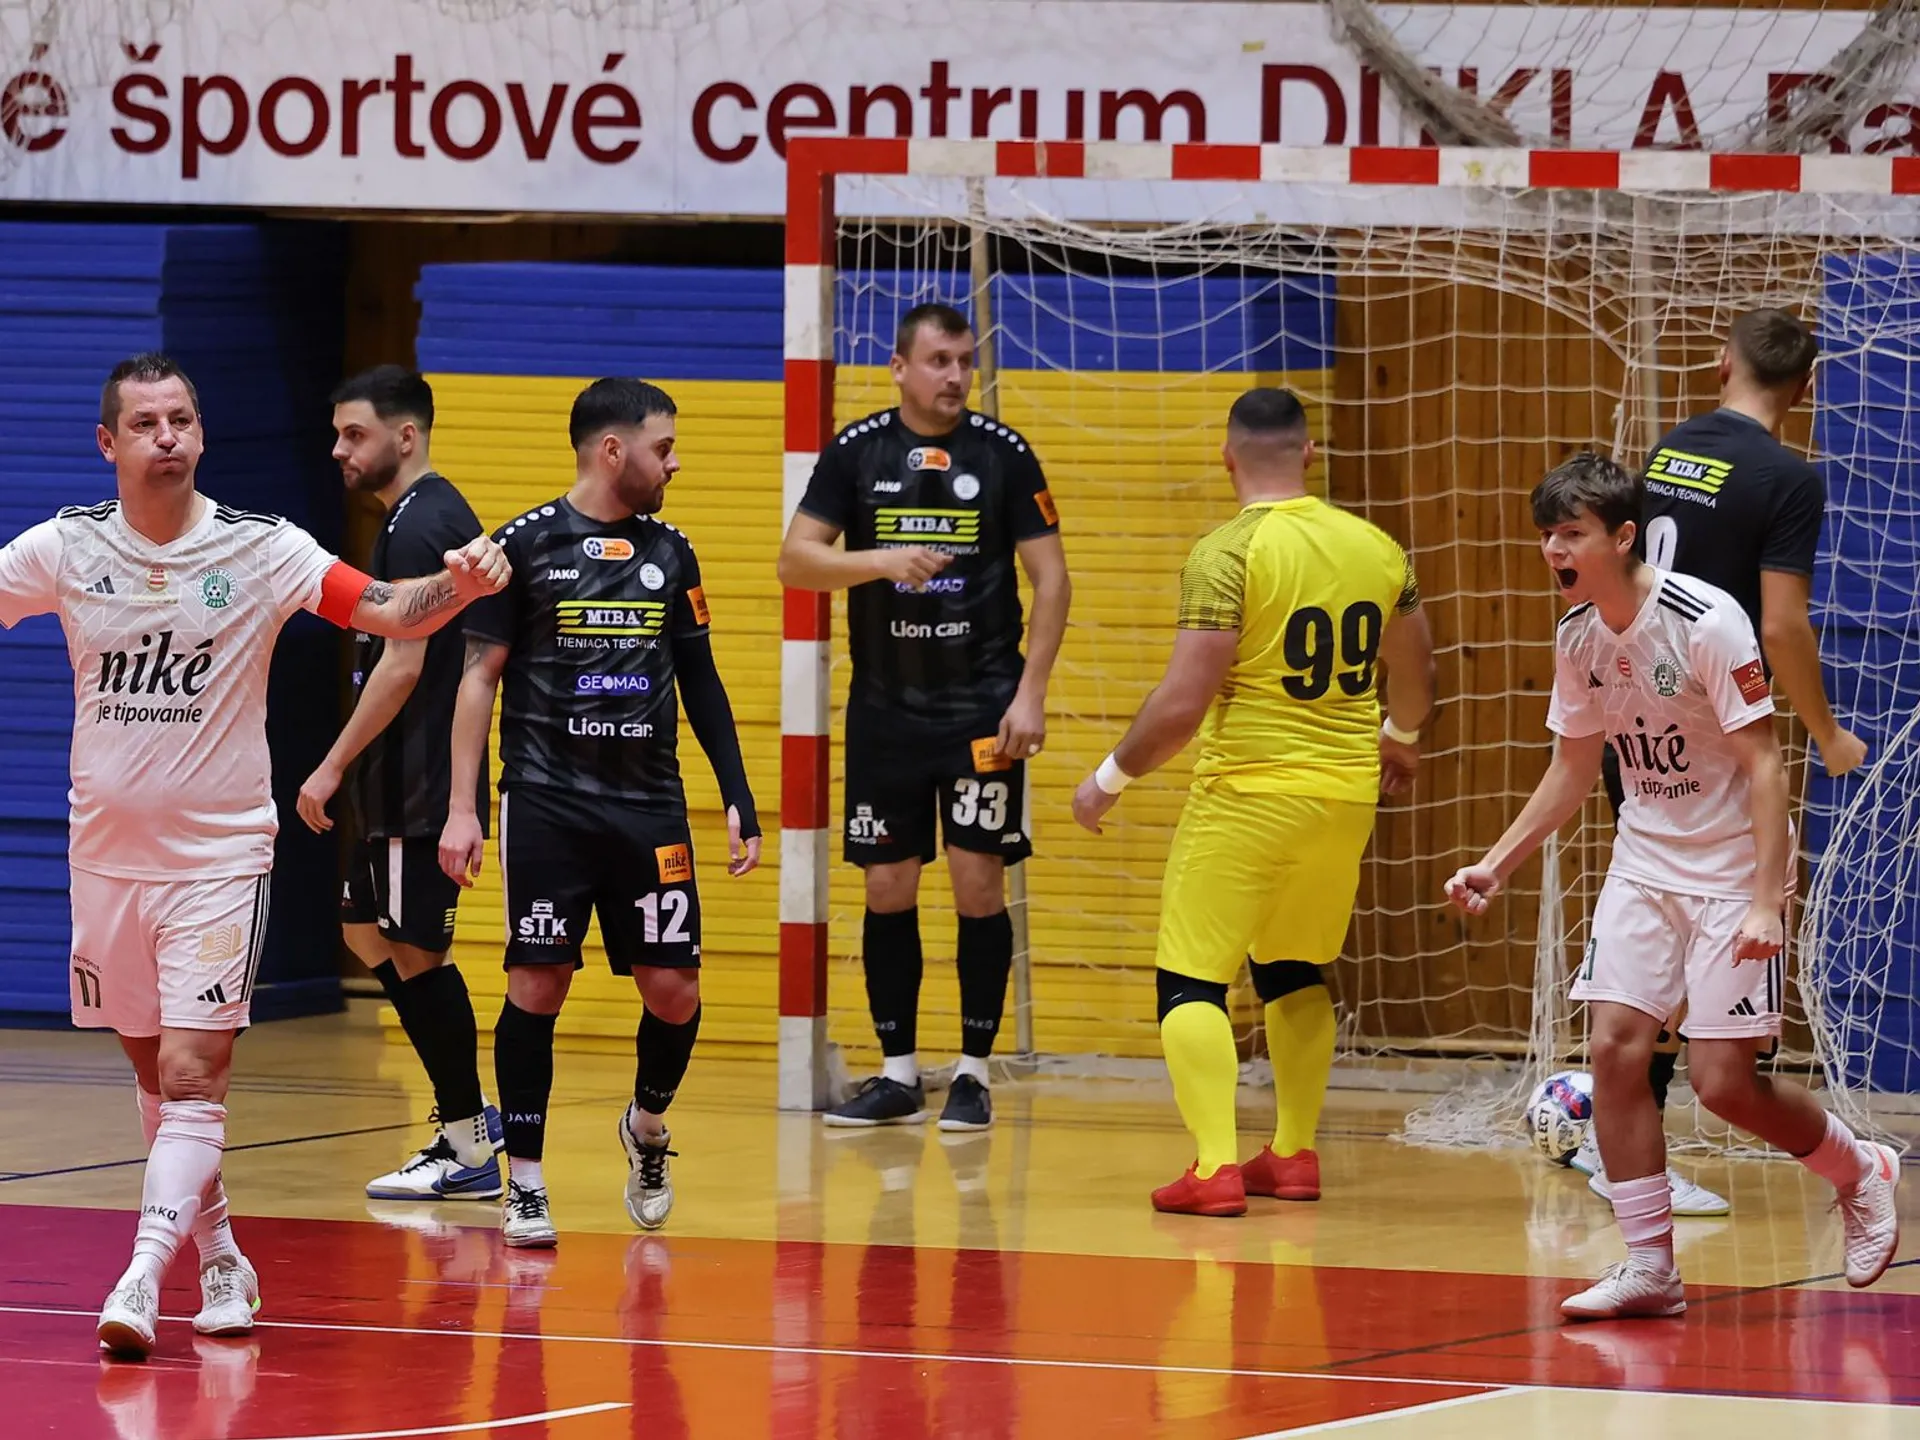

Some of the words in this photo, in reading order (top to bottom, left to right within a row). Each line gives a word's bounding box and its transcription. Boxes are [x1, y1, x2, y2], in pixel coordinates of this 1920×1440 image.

[110, 43, 642, 179] športové
[692, 60, 1207, 164] centrum
[900, 517, 952, 532] MIBA
[548, 568, 580, 580] JAKO
[585, 609, 641, 626] MIBA
[890, 620, 932, 638] Lion
[1281, 600, 1382, 701] 99
[98, 630, 214, 696] niké
[96, 701, 111, 724] je
[114, 702, 203, 727] tipovanie
[567, 717, 615, 736] Lion
[952, 777, 1008, 831] 33
[518, 913, 568, 936] STK
[635, 890, 690, 943] 12
[507, 1113, 541, 1125] JAKO
[143, 1204, 178, 1222] JAKO
